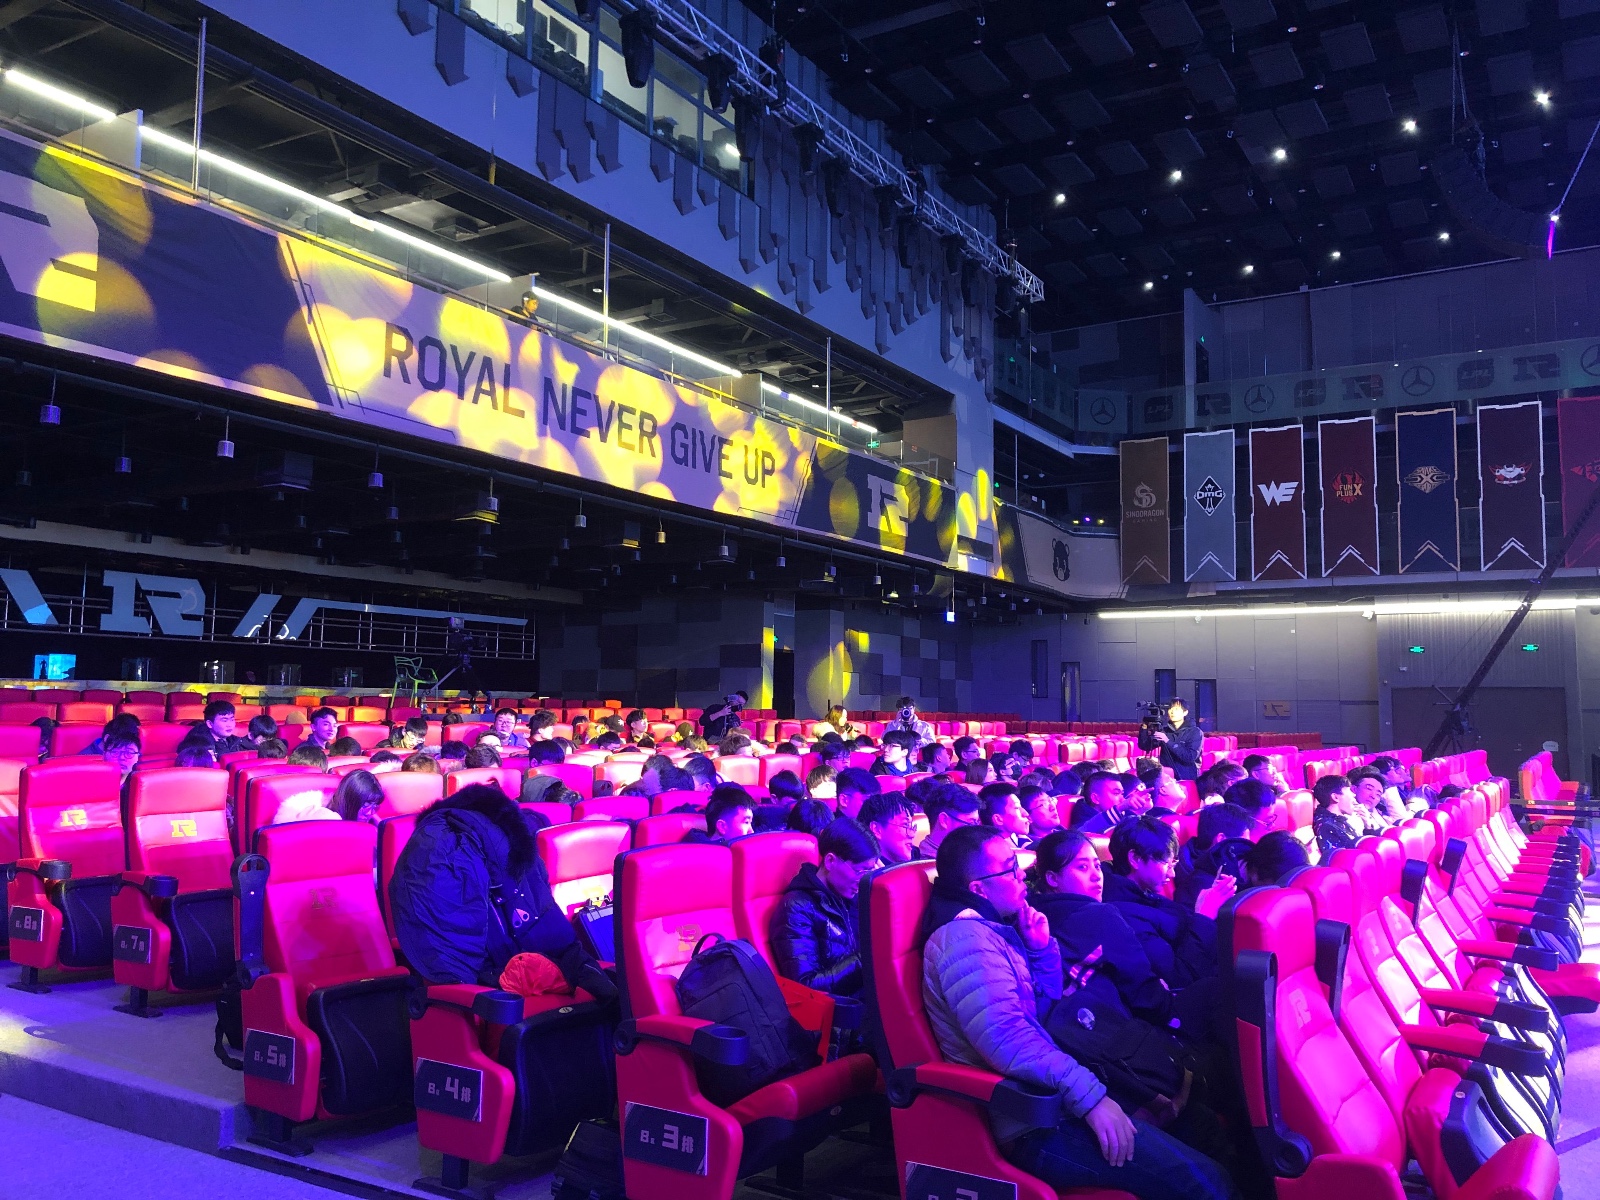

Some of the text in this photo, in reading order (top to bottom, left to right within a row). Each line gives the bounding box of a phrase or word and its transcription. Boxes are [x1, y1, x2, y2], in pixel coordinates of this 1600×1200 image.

[383, 322, 776, 489] ROYAL NEVER GIVE UP
[1256, 480, 1299, 507] WE
[1353, 483, 1363, 496] X
